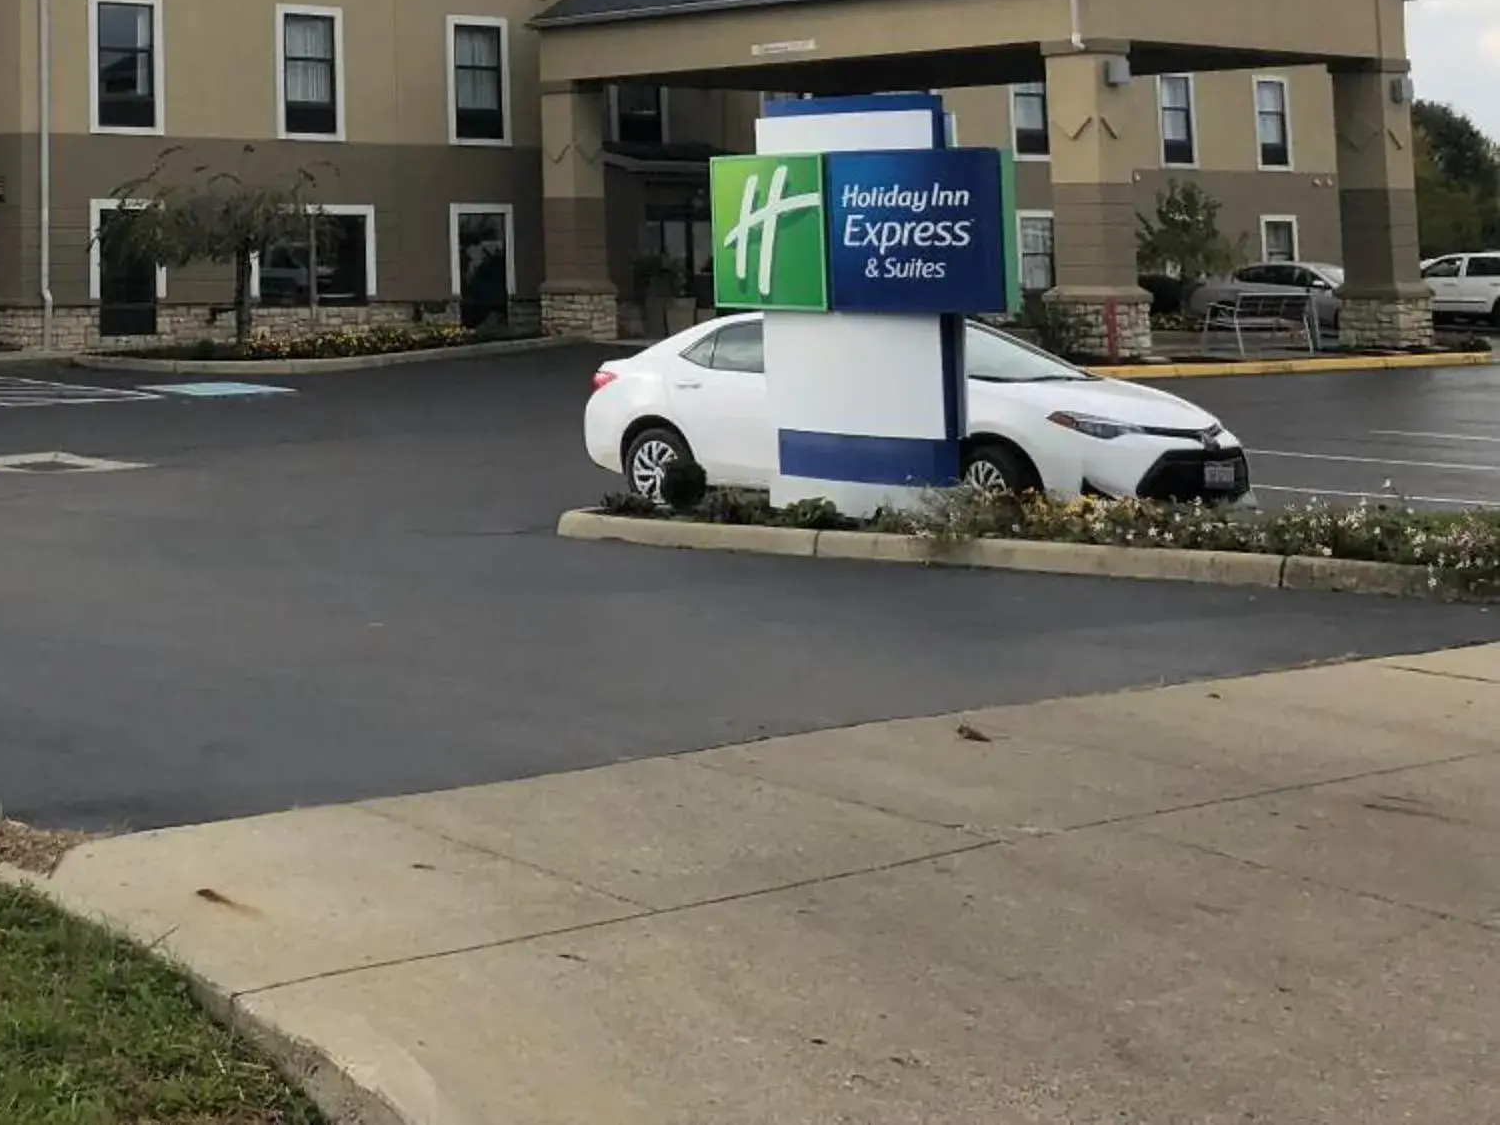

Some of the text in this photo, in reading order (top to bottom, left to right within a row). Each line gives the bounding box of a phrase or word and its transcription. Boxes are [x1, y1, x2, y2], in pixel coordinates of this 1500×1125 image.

[841, 183, 970, 212] Holiday Inn
[843, 214, 972, 254] Express
[864, 257, 946, 279] & Suites
